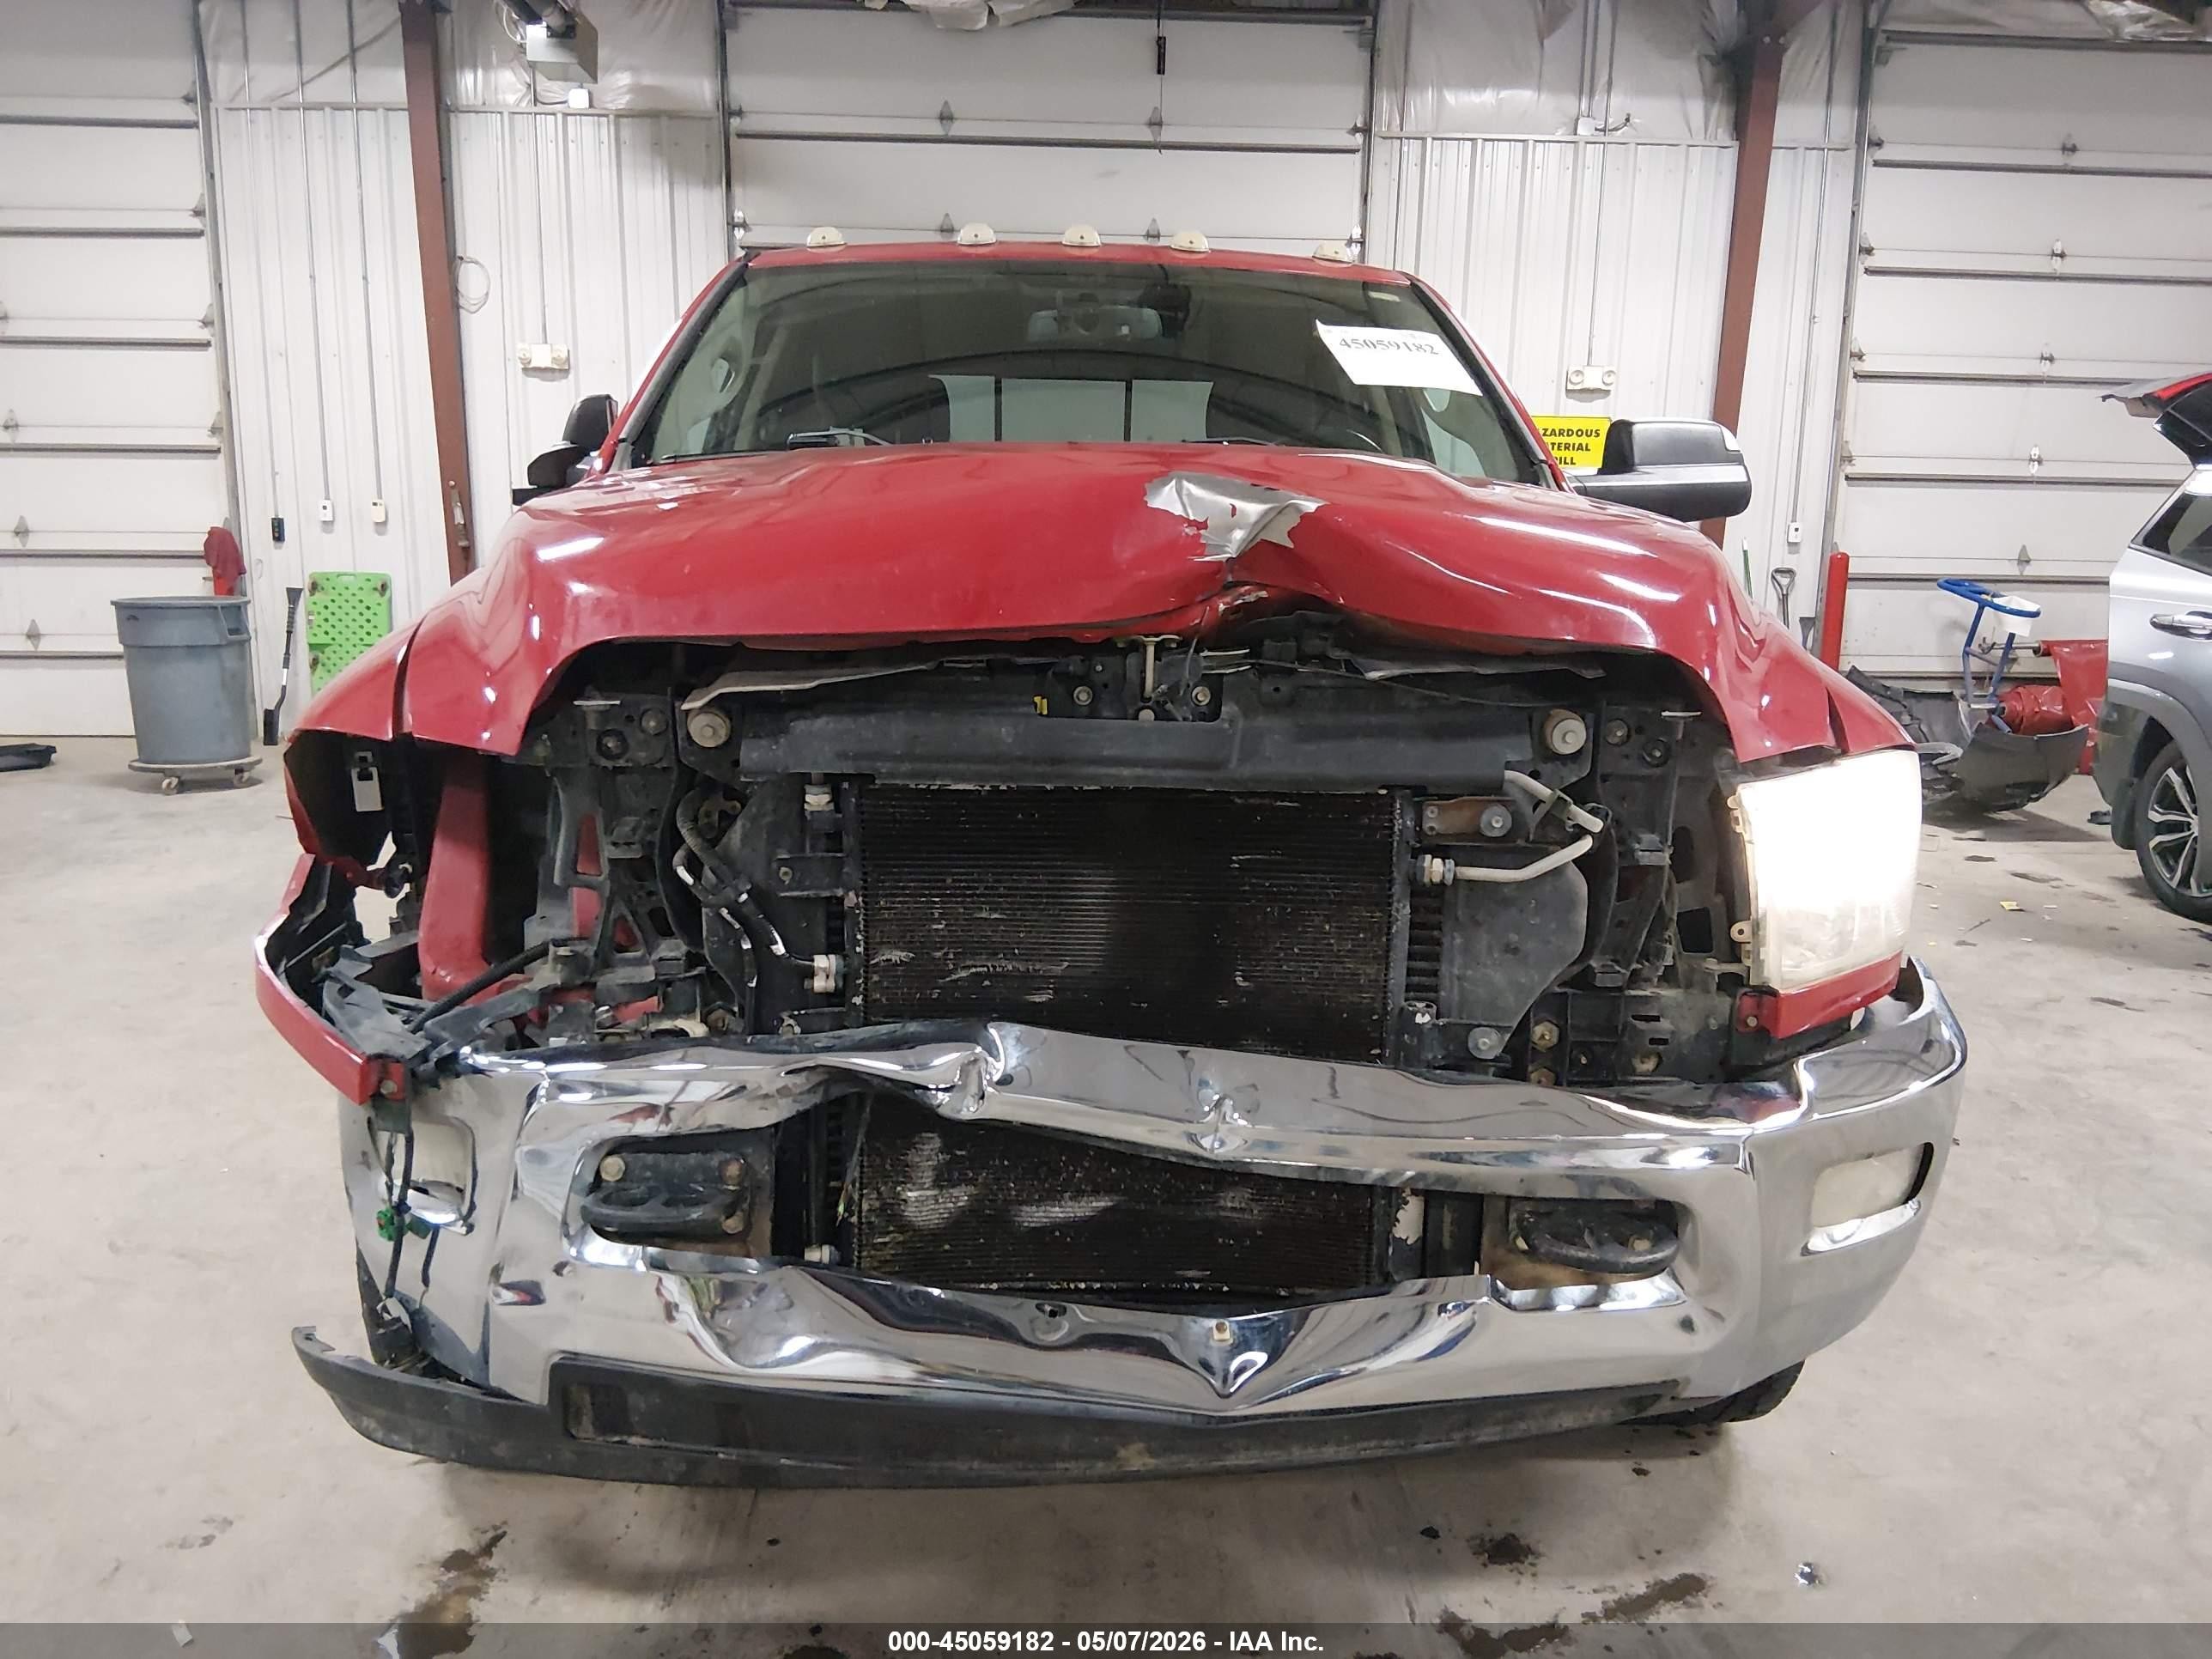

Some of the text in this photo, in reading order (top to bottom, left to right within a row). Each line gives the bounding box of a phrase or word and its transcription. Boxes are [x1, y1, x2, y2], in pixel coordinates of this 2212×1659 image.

[1339, 337, 1439, 356] 45059182
[1539, 428, 1601, 438] ZARDOUS
[1546, 441, 1591, 452] TERIAL
